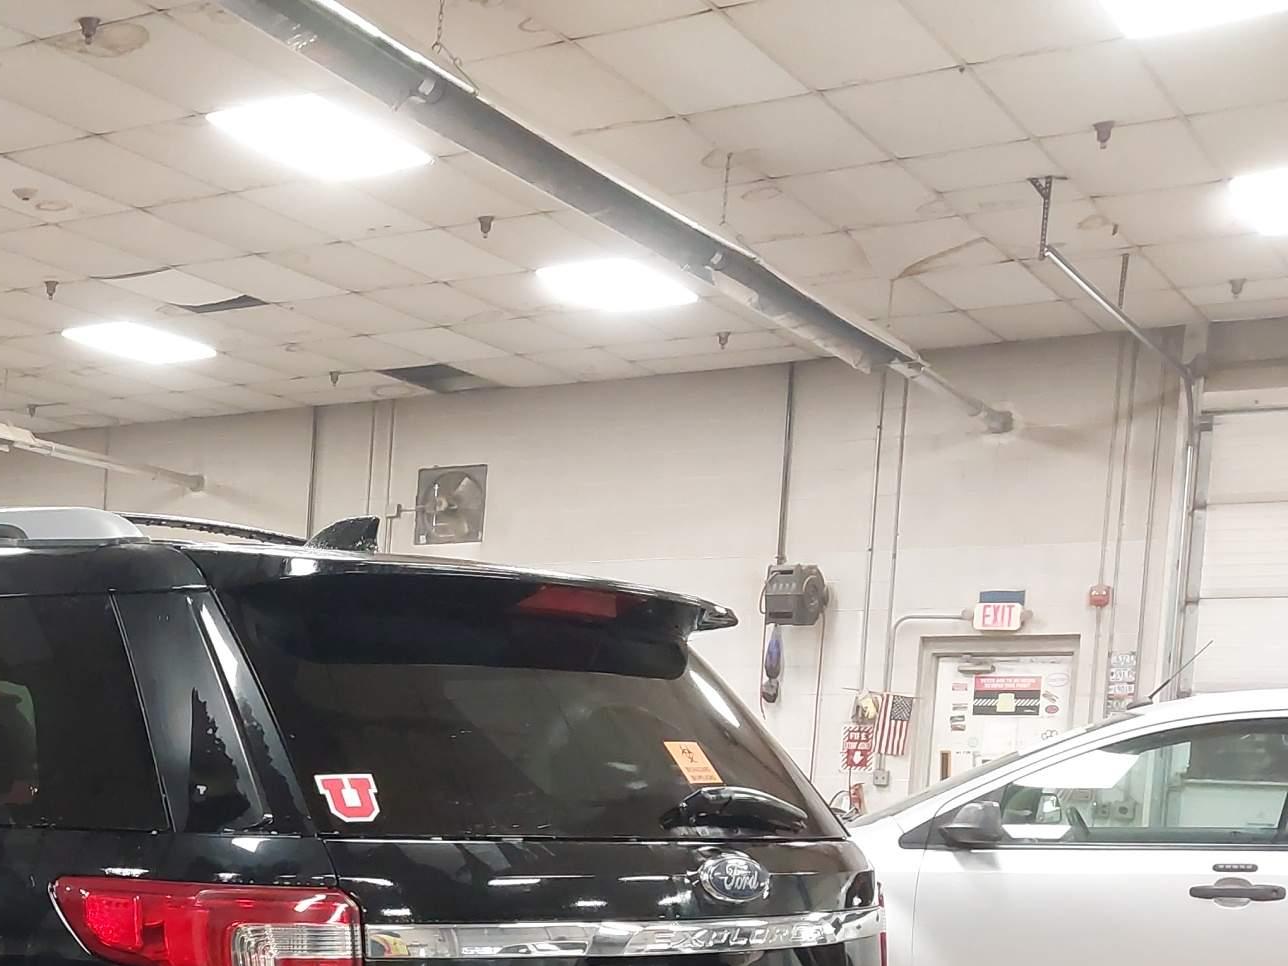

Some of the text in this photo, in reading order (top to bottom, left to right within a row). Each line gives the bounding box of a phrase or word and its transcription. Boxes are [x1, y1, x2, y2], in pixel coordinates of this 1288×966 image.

[982, 604, 1016, 627] EXIT
[849, 731, 867, 741] FIRE
[317, 776, 378, 820] U
[719, 859, 759, 890] Ford
